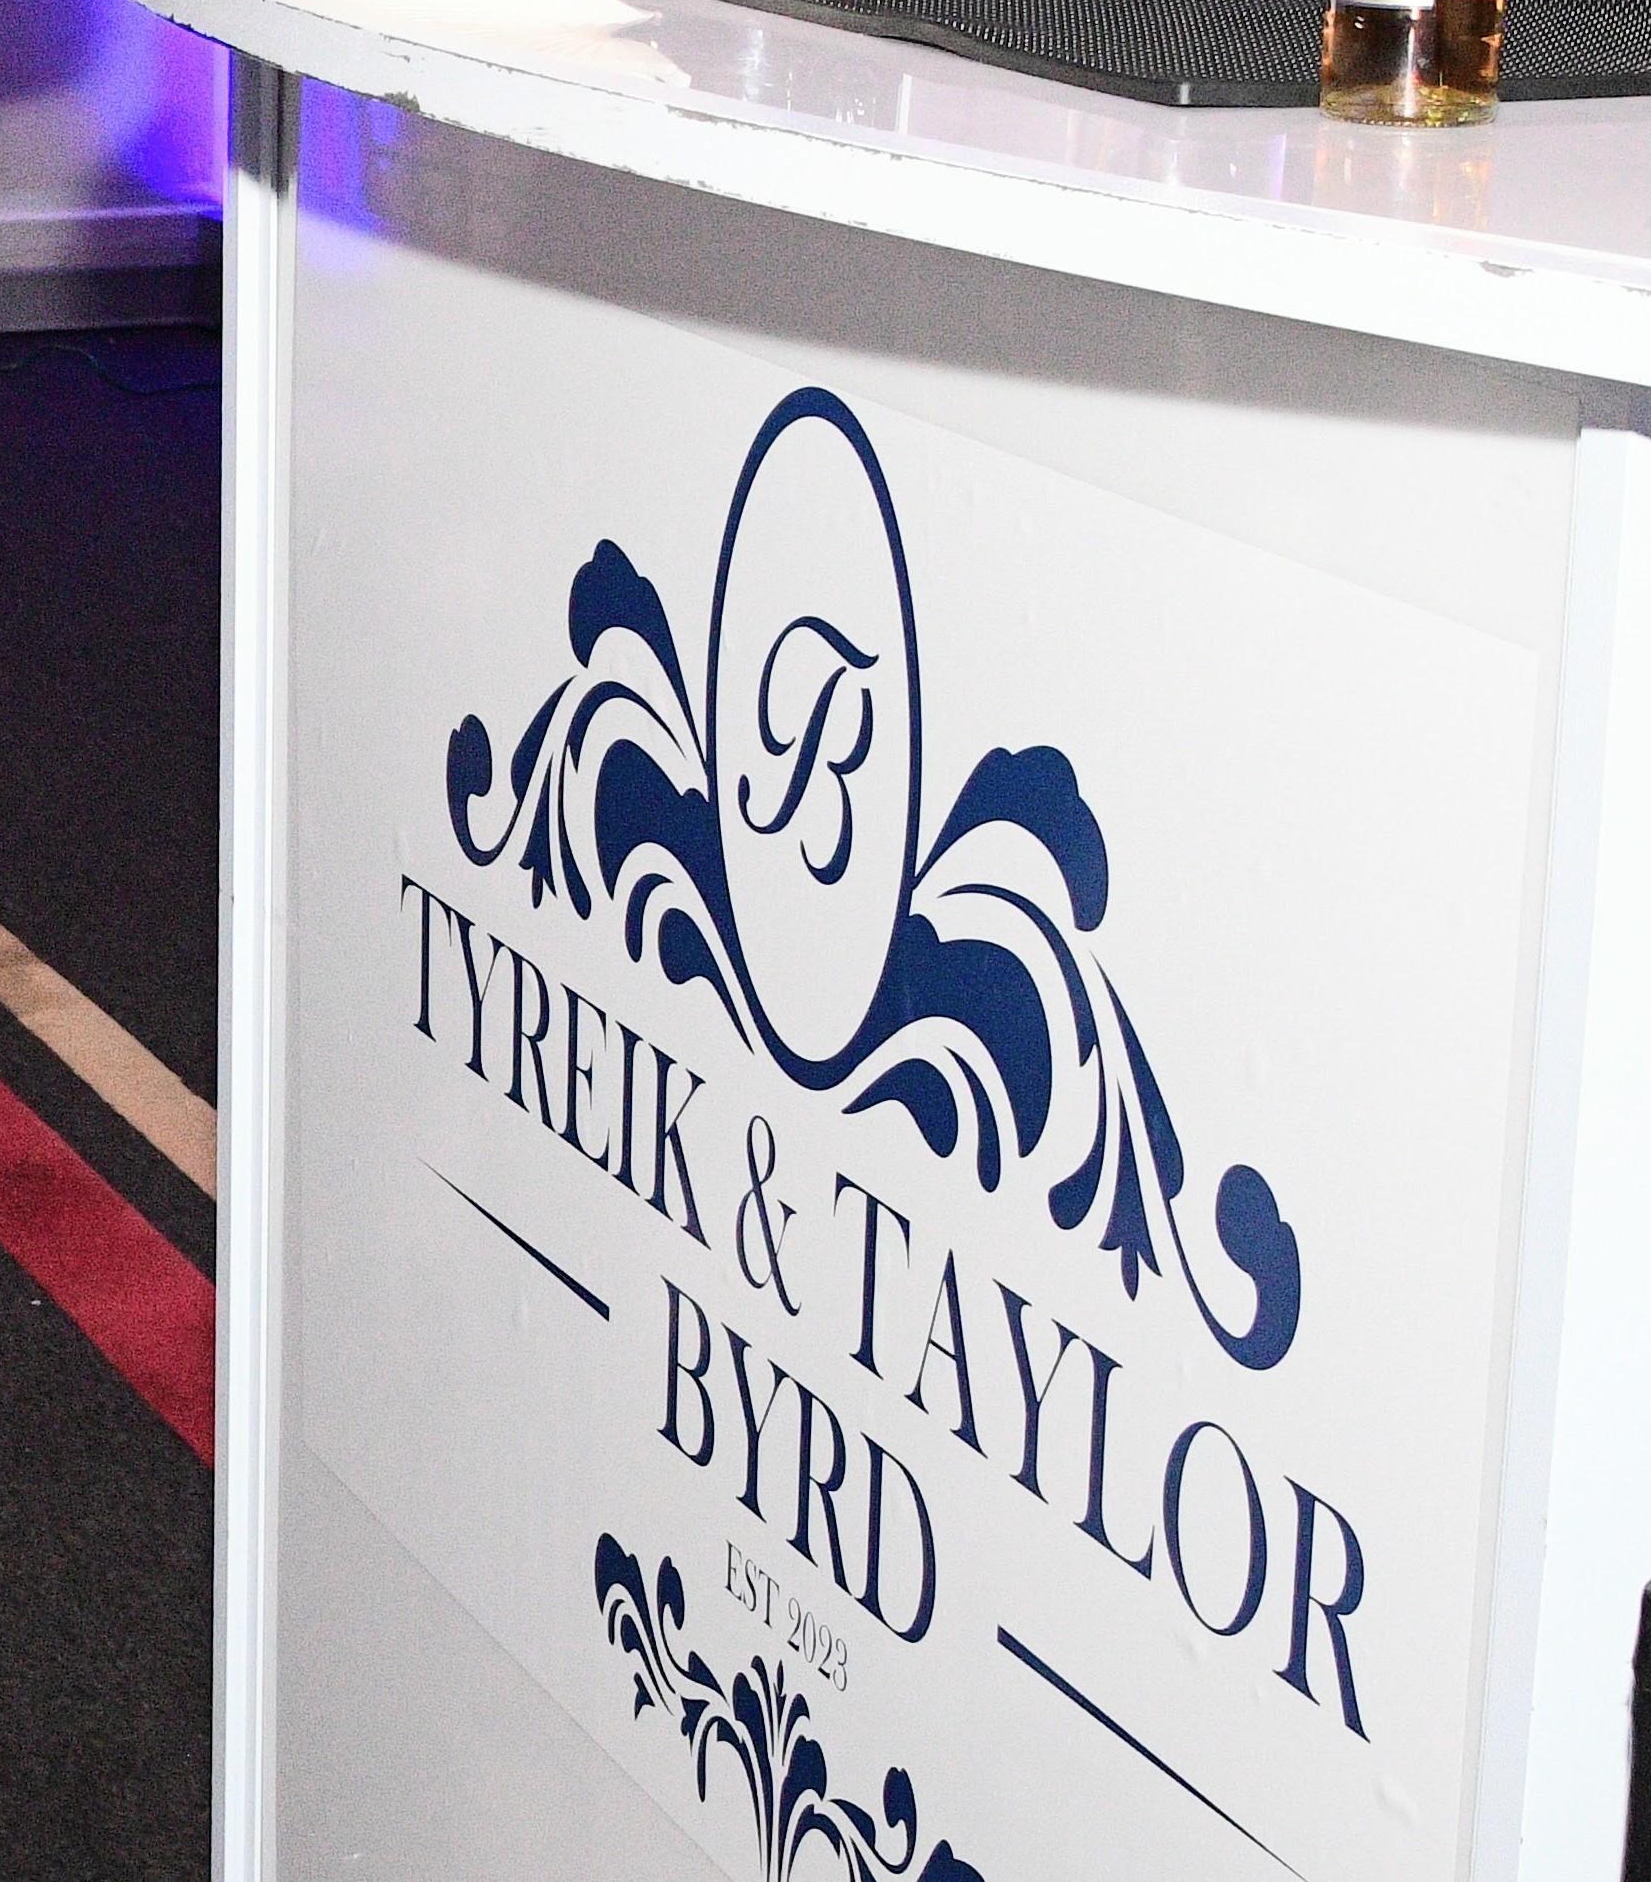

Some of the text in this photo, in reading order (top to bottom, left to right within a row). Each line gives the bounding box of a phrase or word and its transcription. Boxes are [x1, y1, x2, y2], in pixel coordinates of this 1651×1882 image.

[400, 872, 1372, 1745] TYREIK & TAYLOR
[656, 1275, 938, 1645] BYRD
[724, 1539, 848, 1693] EST 2023
